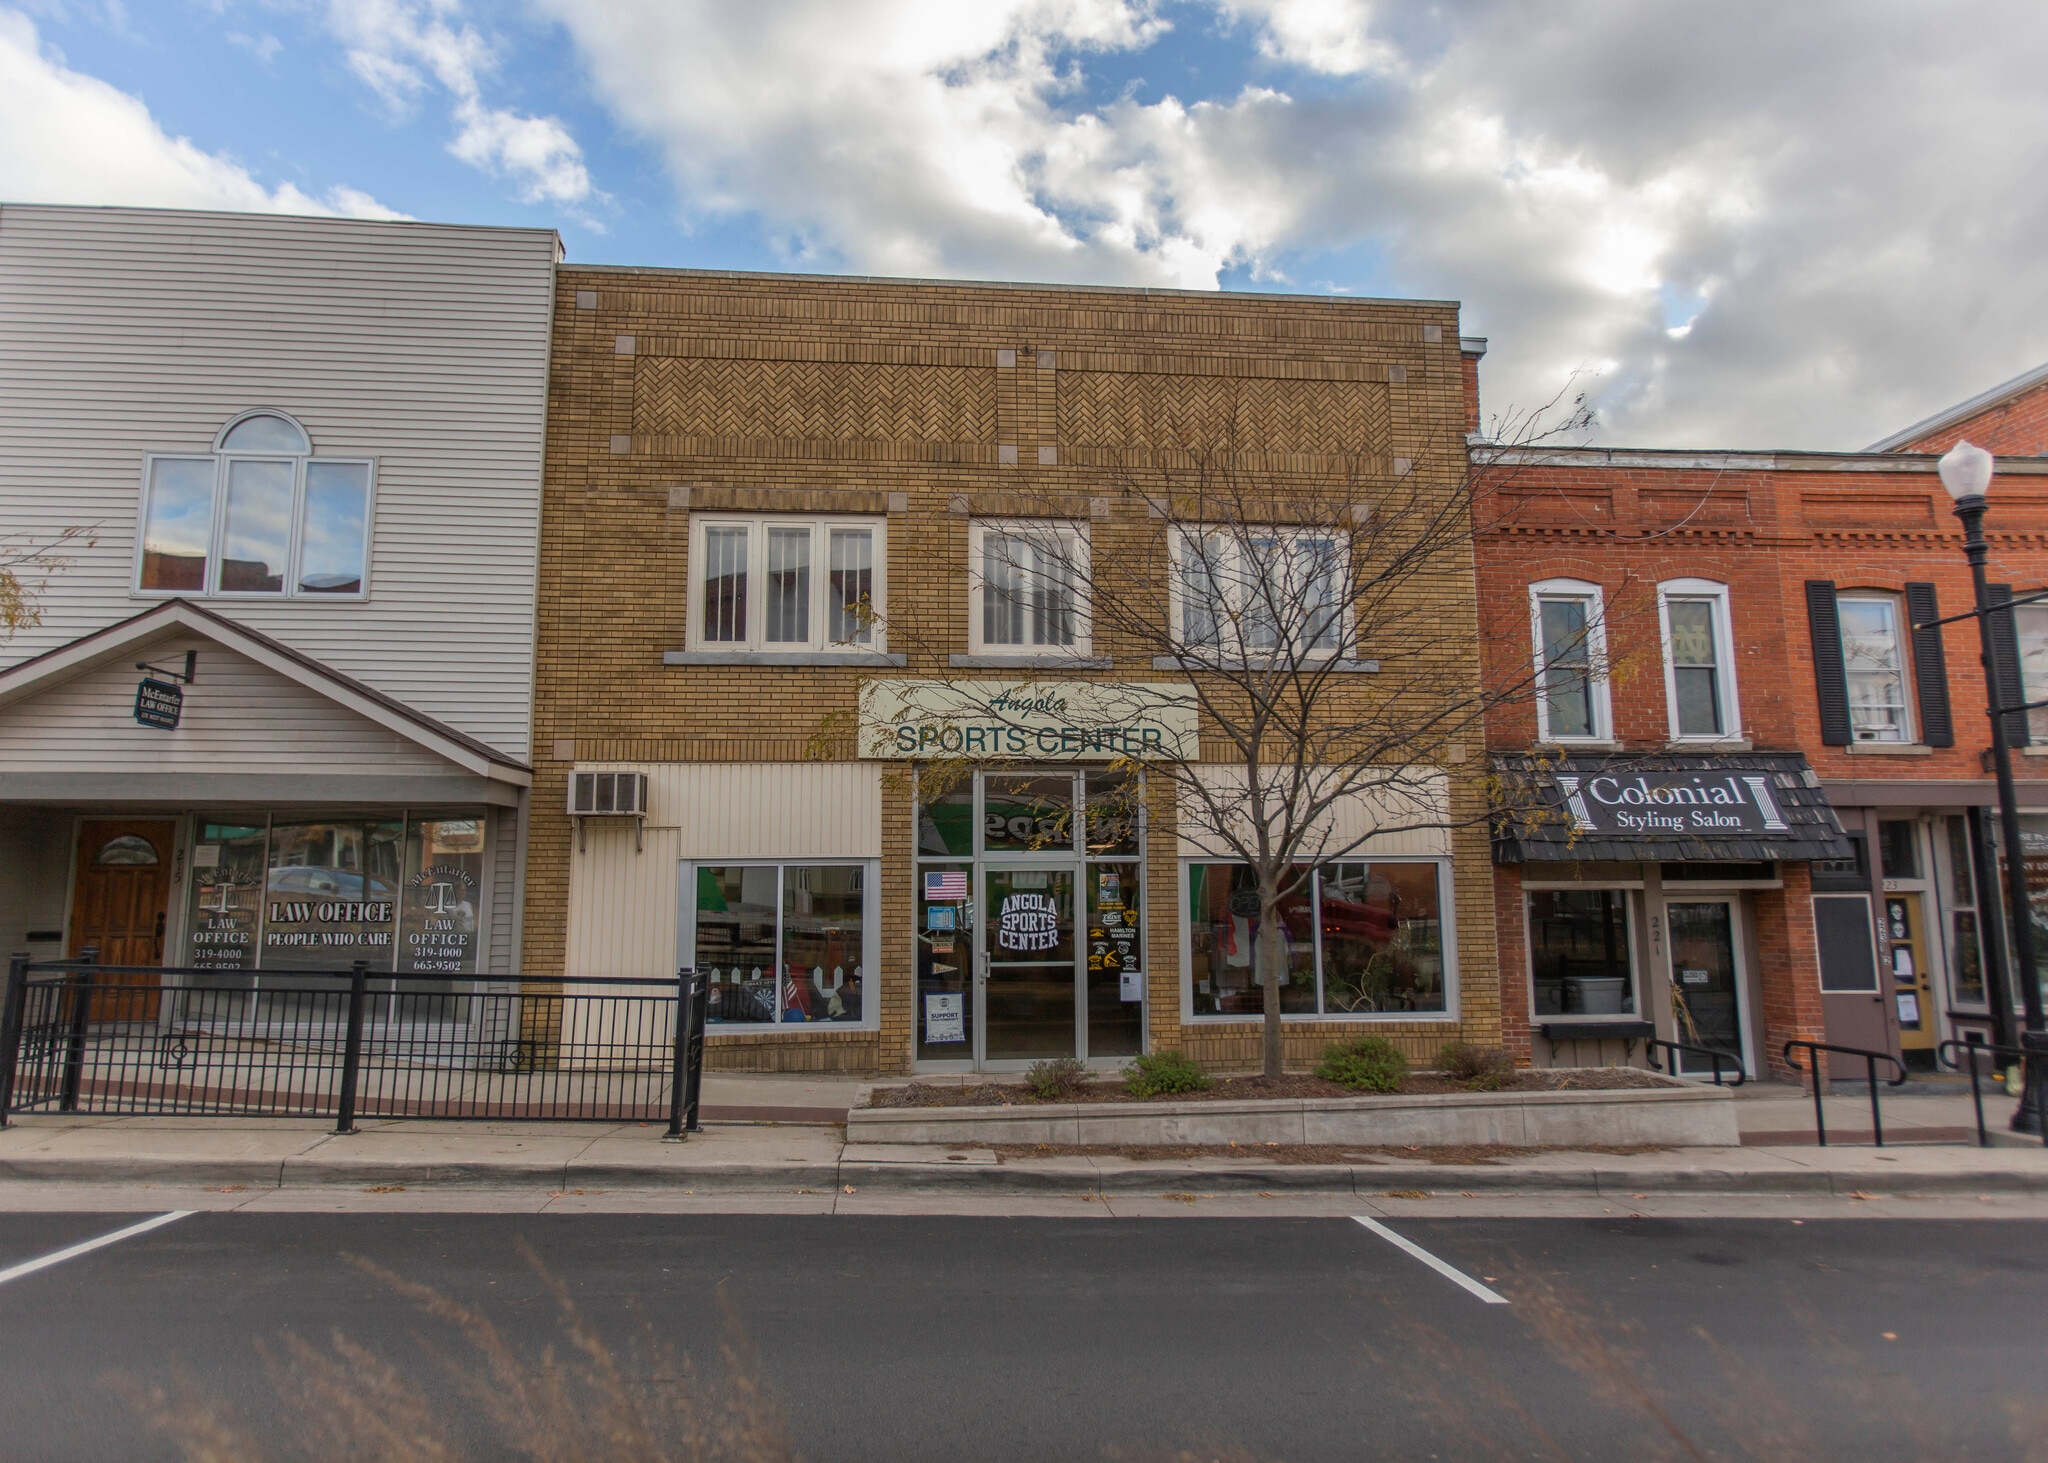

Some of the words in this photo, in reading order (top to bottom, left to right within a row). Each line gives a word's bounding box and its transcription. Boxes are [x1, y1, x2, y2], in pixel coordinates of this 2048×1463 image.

[140, 698, 157, 709] LAW
[157, 702, 179, 715] OFFICE
[988, 688, 1067, 720] Angola
[896, 725, 1027, 752] SPORTS
[1036, 727, 1162, 752] CENTER
[1590, 777, 1747, 805] Colonial
[1617, 811, 1683, 832] Styling
[1691, 811, 1741, 827] Salon
[410, 865, 475, 888] McEntarfer
[269, 901, 316, 922] LAW
[318, 902, 392, 922] OFFICE
[1001, 893, 1057, 916] ANGOLA
[208, 918, 237, 929] LAW
[424, 919, 456, 930] LAW
[1002, 913, 1057, 932] SPORTS
[193, 932, 249, 944] OFFICE
[267, 932, 319, 946] PEOPLE
[322, 932, 355, 946] WHO
[357, 932, 392, 946] CARE
[409, 933, 468, 945] OFFICE
[1000, 929, 1059, 950] CENTER
[195, 949, 242, 959] 319-4000
[413, 960, 461, 971] 665-9502
